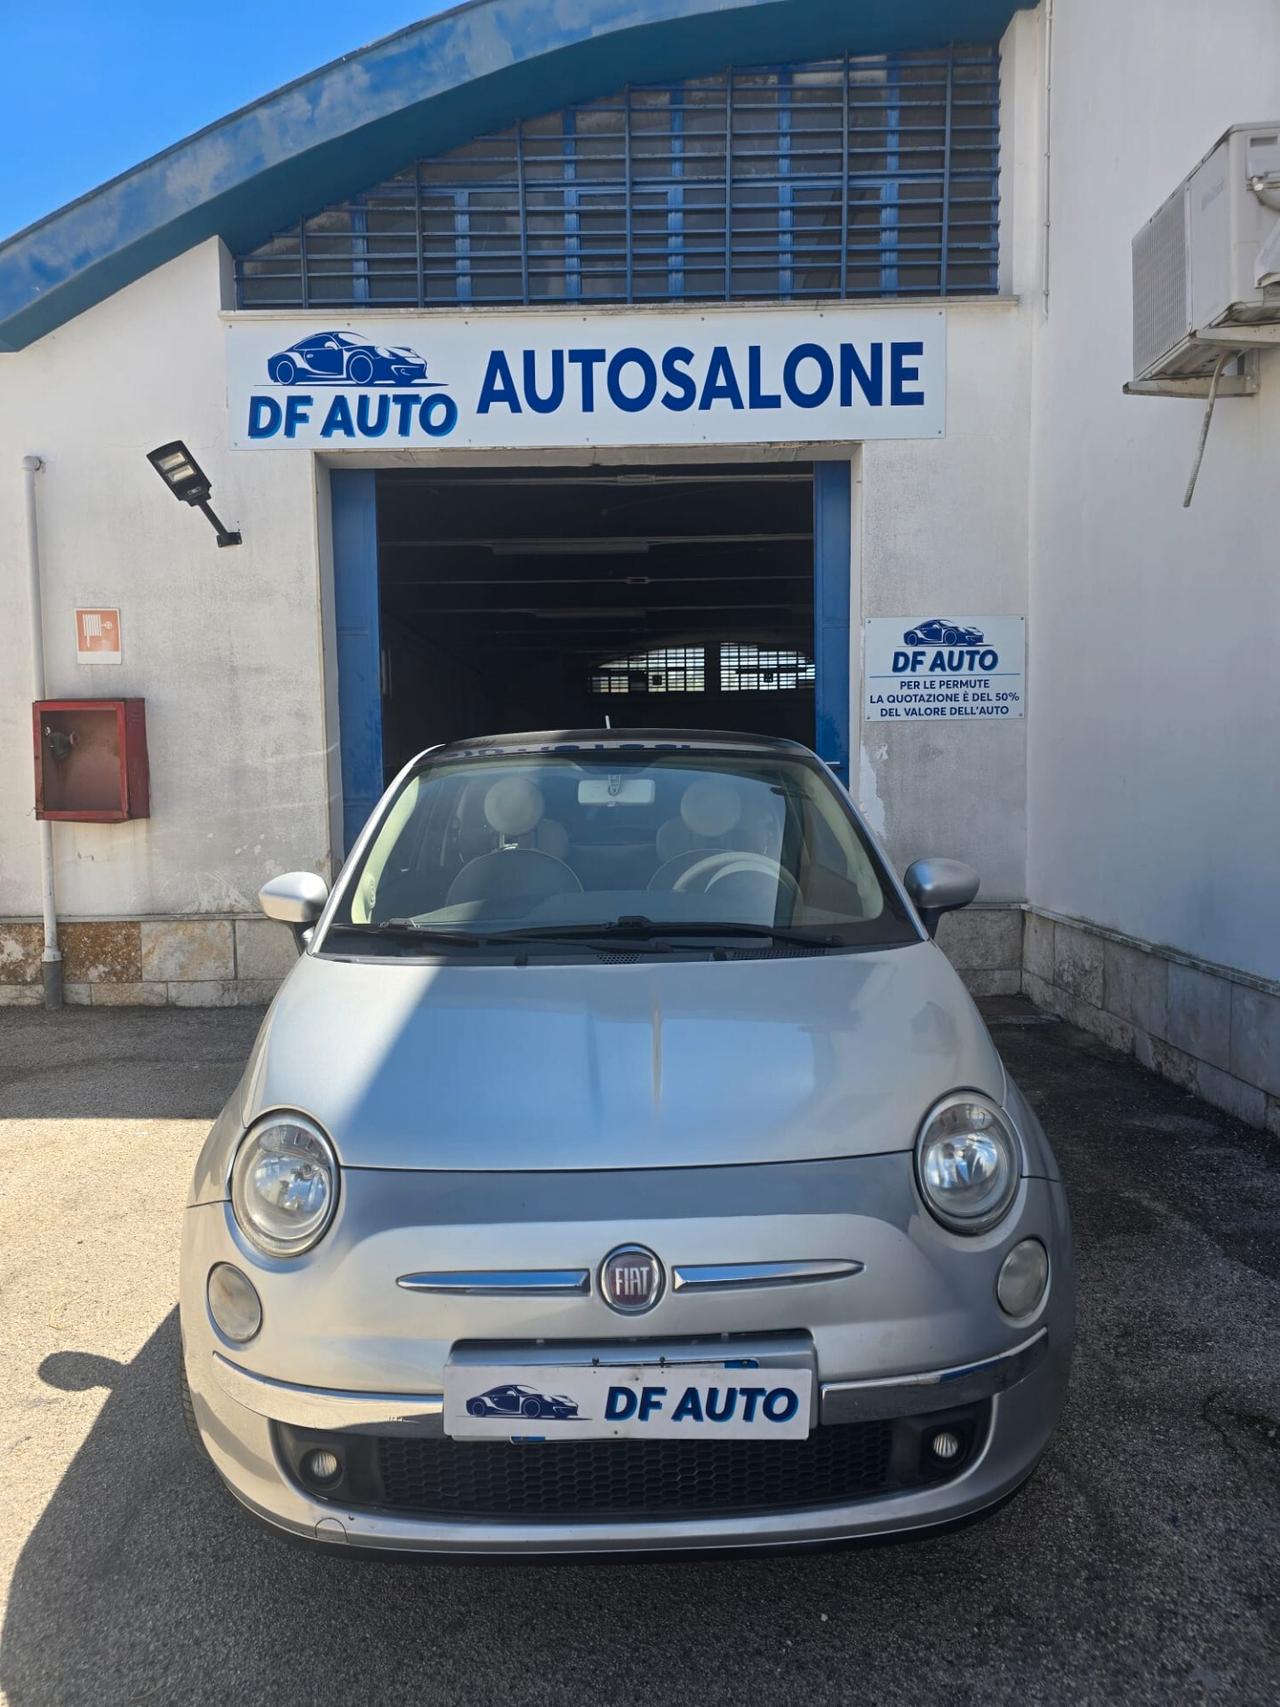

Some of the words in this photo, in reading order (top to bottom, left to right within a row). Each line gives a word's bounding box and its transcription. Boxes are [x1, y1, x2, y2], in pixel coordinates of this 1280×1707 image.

[476, 342, 924, 414] AUTOSALONE
[248, 395, 314, 439] DF
[320, 393, 458, 438] AUTO
[892, 651, 926, 673] DF
[929, 649, 999, 673] AUTO
[870, 695, 883, 704] LA
[886, 693, 960, 704] QUOTAZIONE
[972, 692, 992, 702] DEL
[995, 692, 1020, 702] 50%
[900, 680, 920, 690] PER
[923, 680, 936, 690] LE
[939, 679, 990, 690] PERMUTE
[880, 708, 901, 717] DEL
[904, 707, 947, 717] VALORE
[950, 705, 1010, 716] DELL'AUTO
[615, 1266, 650, 1296] FIAT
[604, 1386, 668, 1422] DF
[671, 1386, 800, 1423] AUTO
